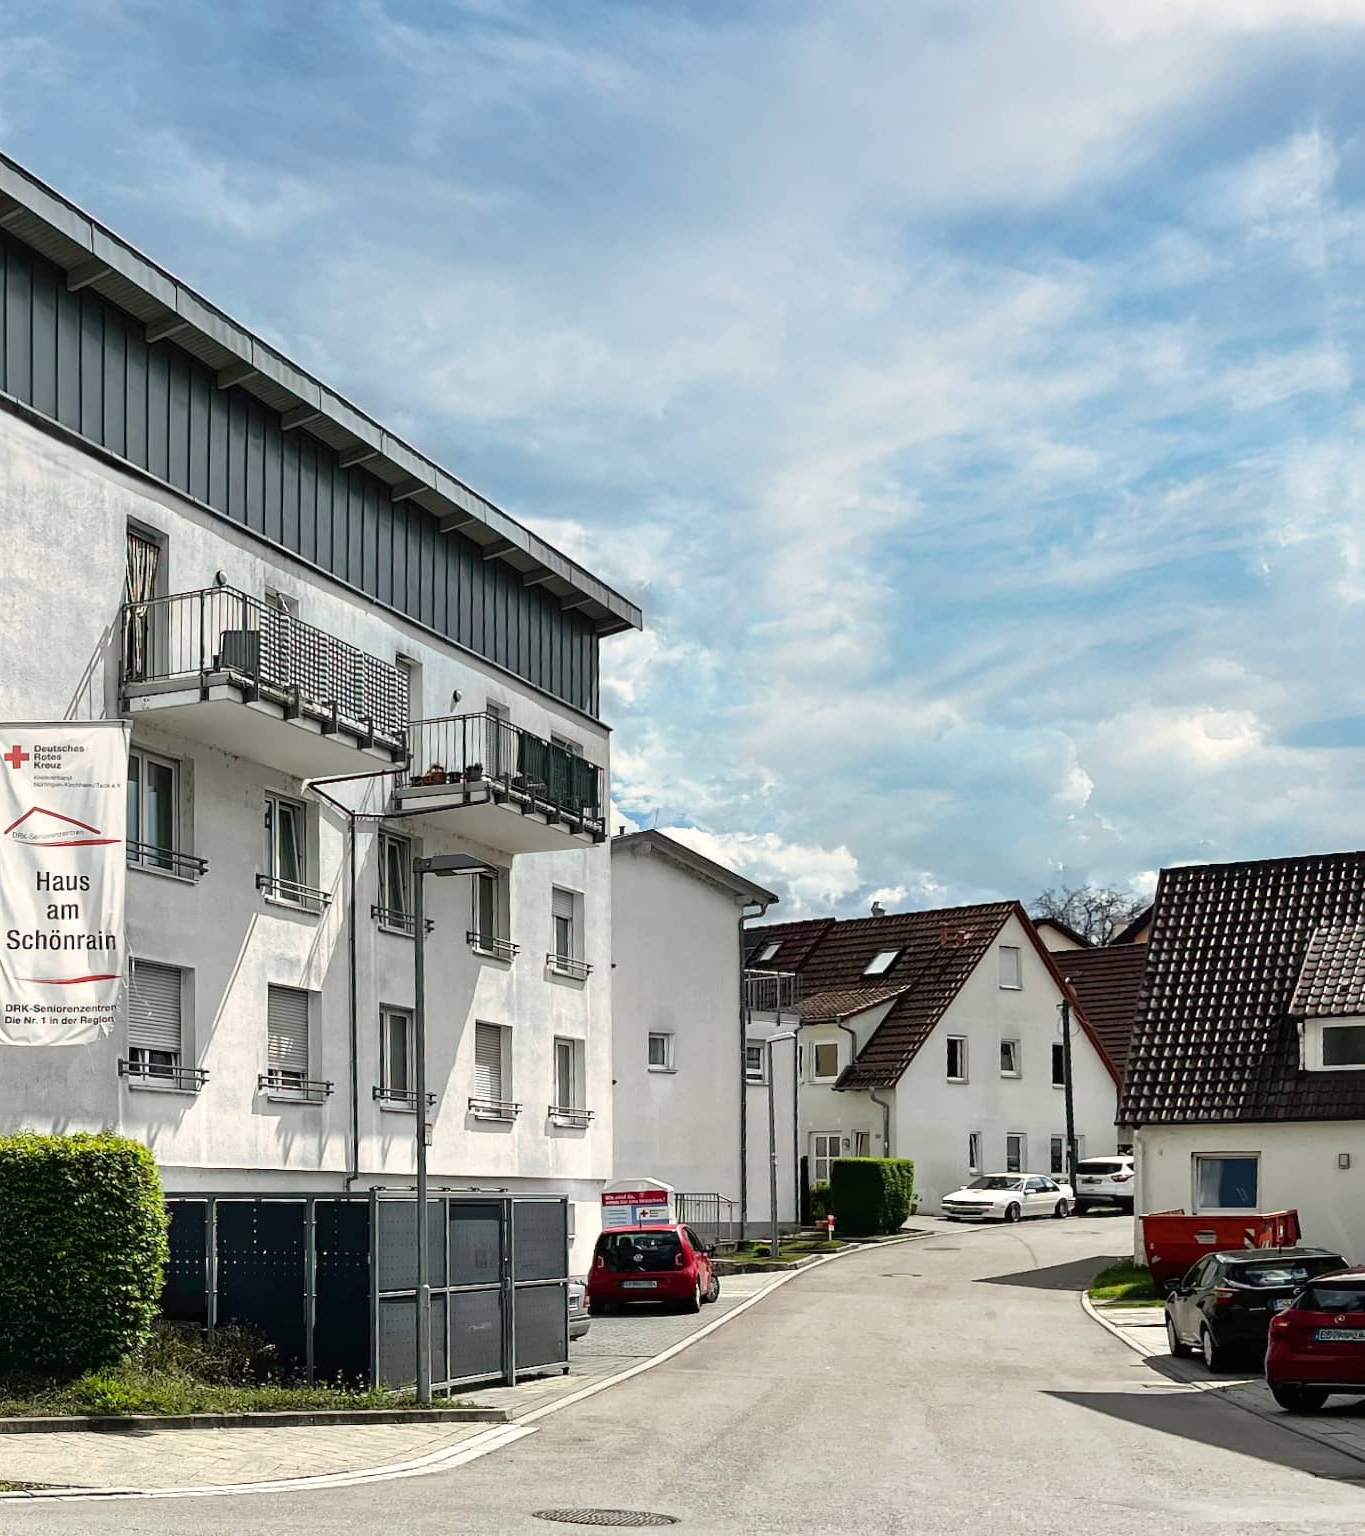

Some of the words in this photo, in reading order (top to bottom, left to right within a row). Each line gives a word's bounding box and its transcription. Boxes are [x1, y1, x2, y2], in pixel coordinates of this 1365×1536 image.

[33, 745, 85, 753] Deutsches
[33, 753, 62, 761] Rotes
[36, 871, 90, 892] Haus
[47, 903, 79, 920] am
[6, 929, 117, 950] Schönrain
[5, 1004, 117, 1013] DRK-Seniorenzentren
[4, 1016, 21, 1024] Die
[23, 1016, 39, 1024] Nr.
[49, 1016, 59, 1024] in
[61, 1016, 78, 1024] der
[80, 1016, 115, 1026] Region
